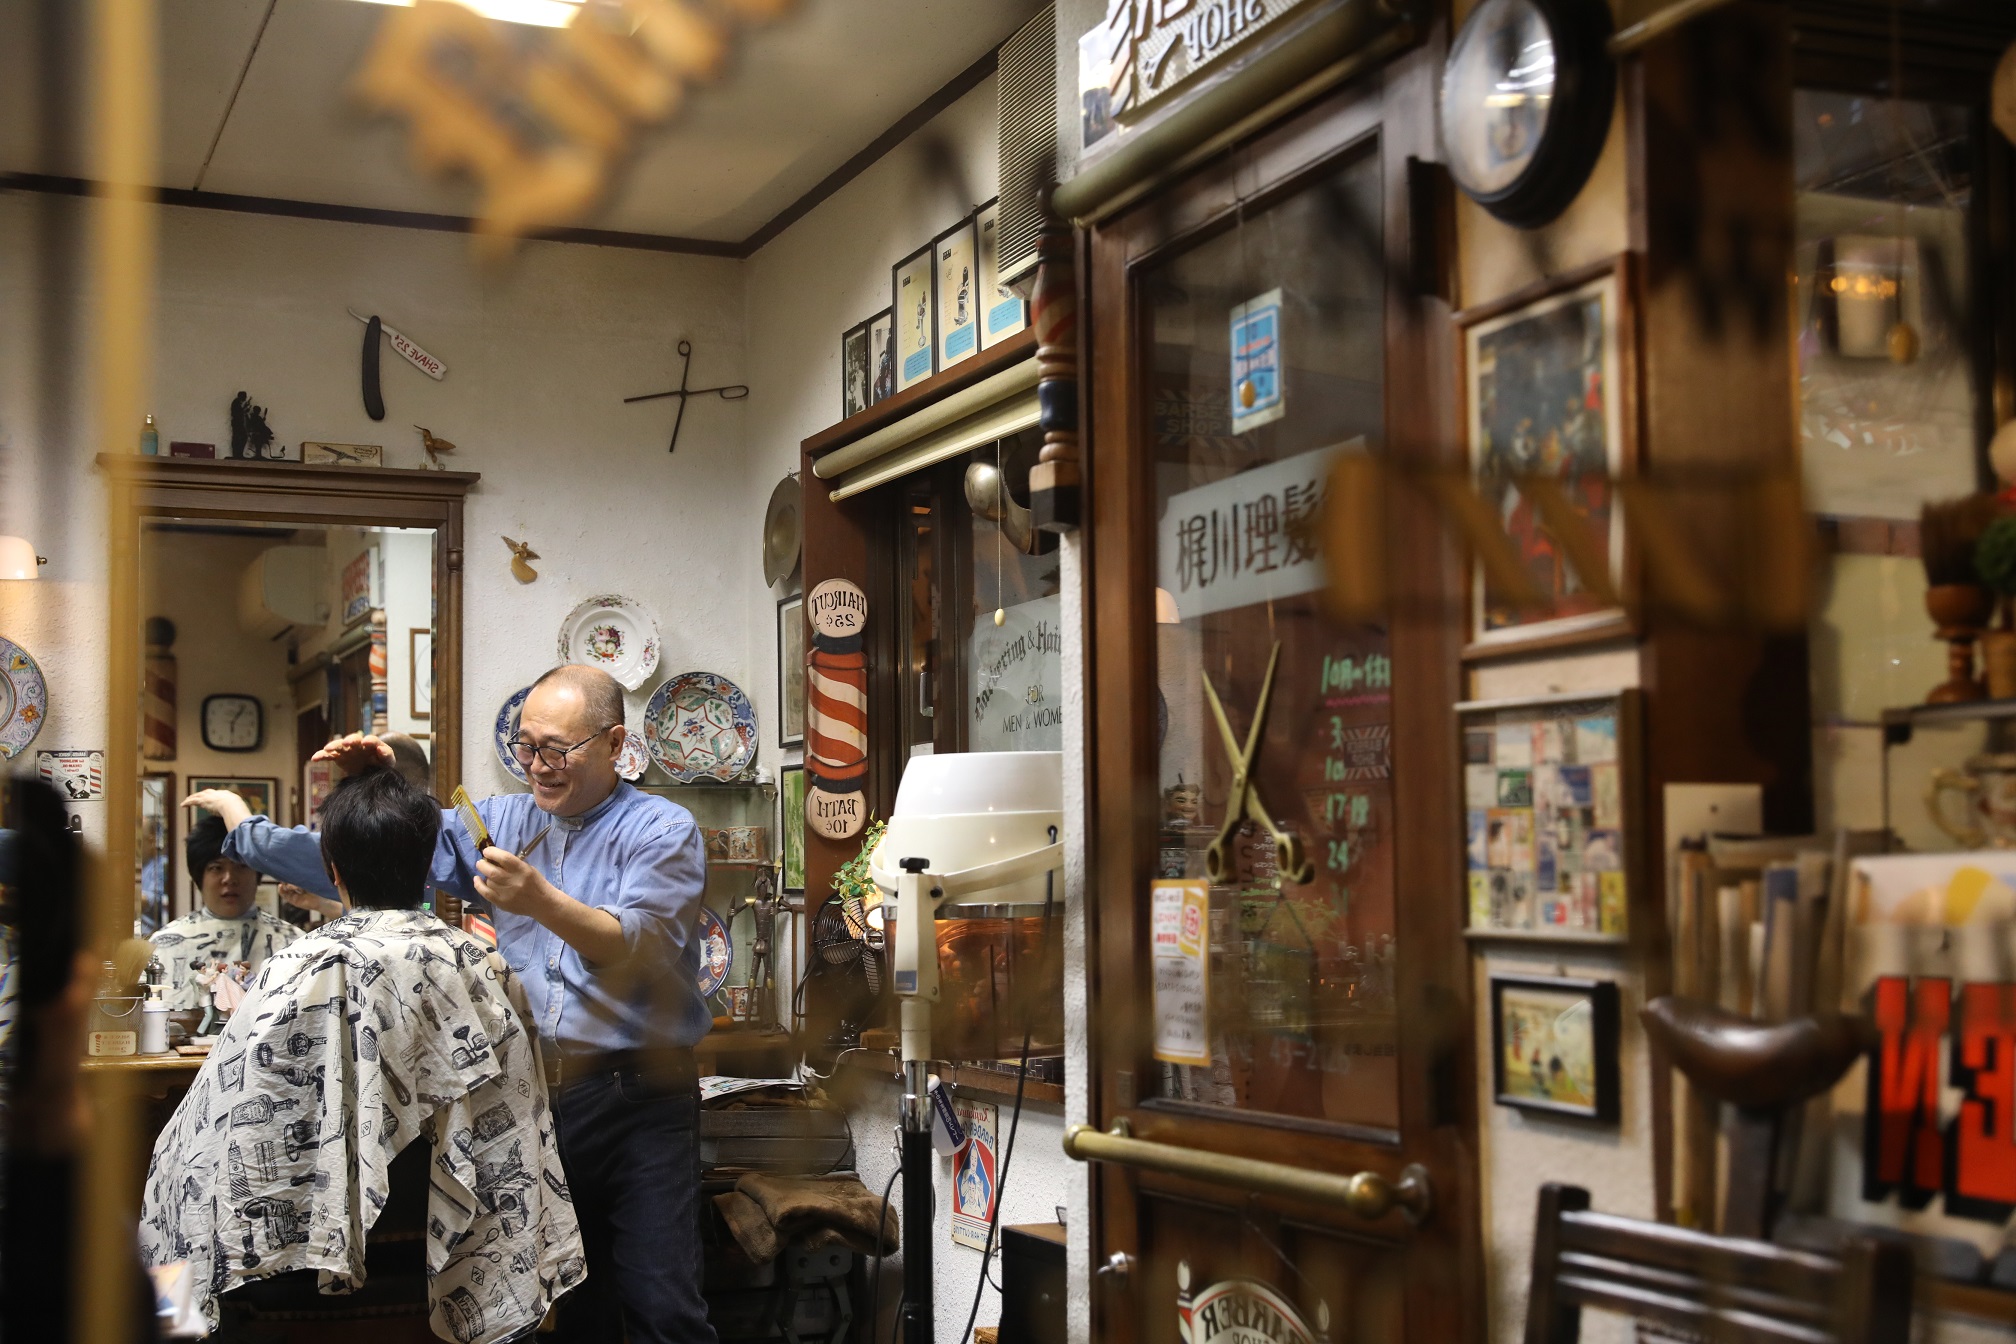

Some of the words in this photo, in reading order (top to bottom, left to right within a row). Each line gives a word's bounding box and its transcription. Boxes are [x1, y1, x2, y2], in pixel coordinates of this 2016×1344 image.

[1175, 478, 1330, 593] 梶川理髪
[1027, 630, 1035, 651] &
[1025, 684, 1045, 706] FOR
[1002, 713, 1022, 734] MEN
[1025, 716, 1031, 730] &
[1033, 705, 1062, 728] WOME
